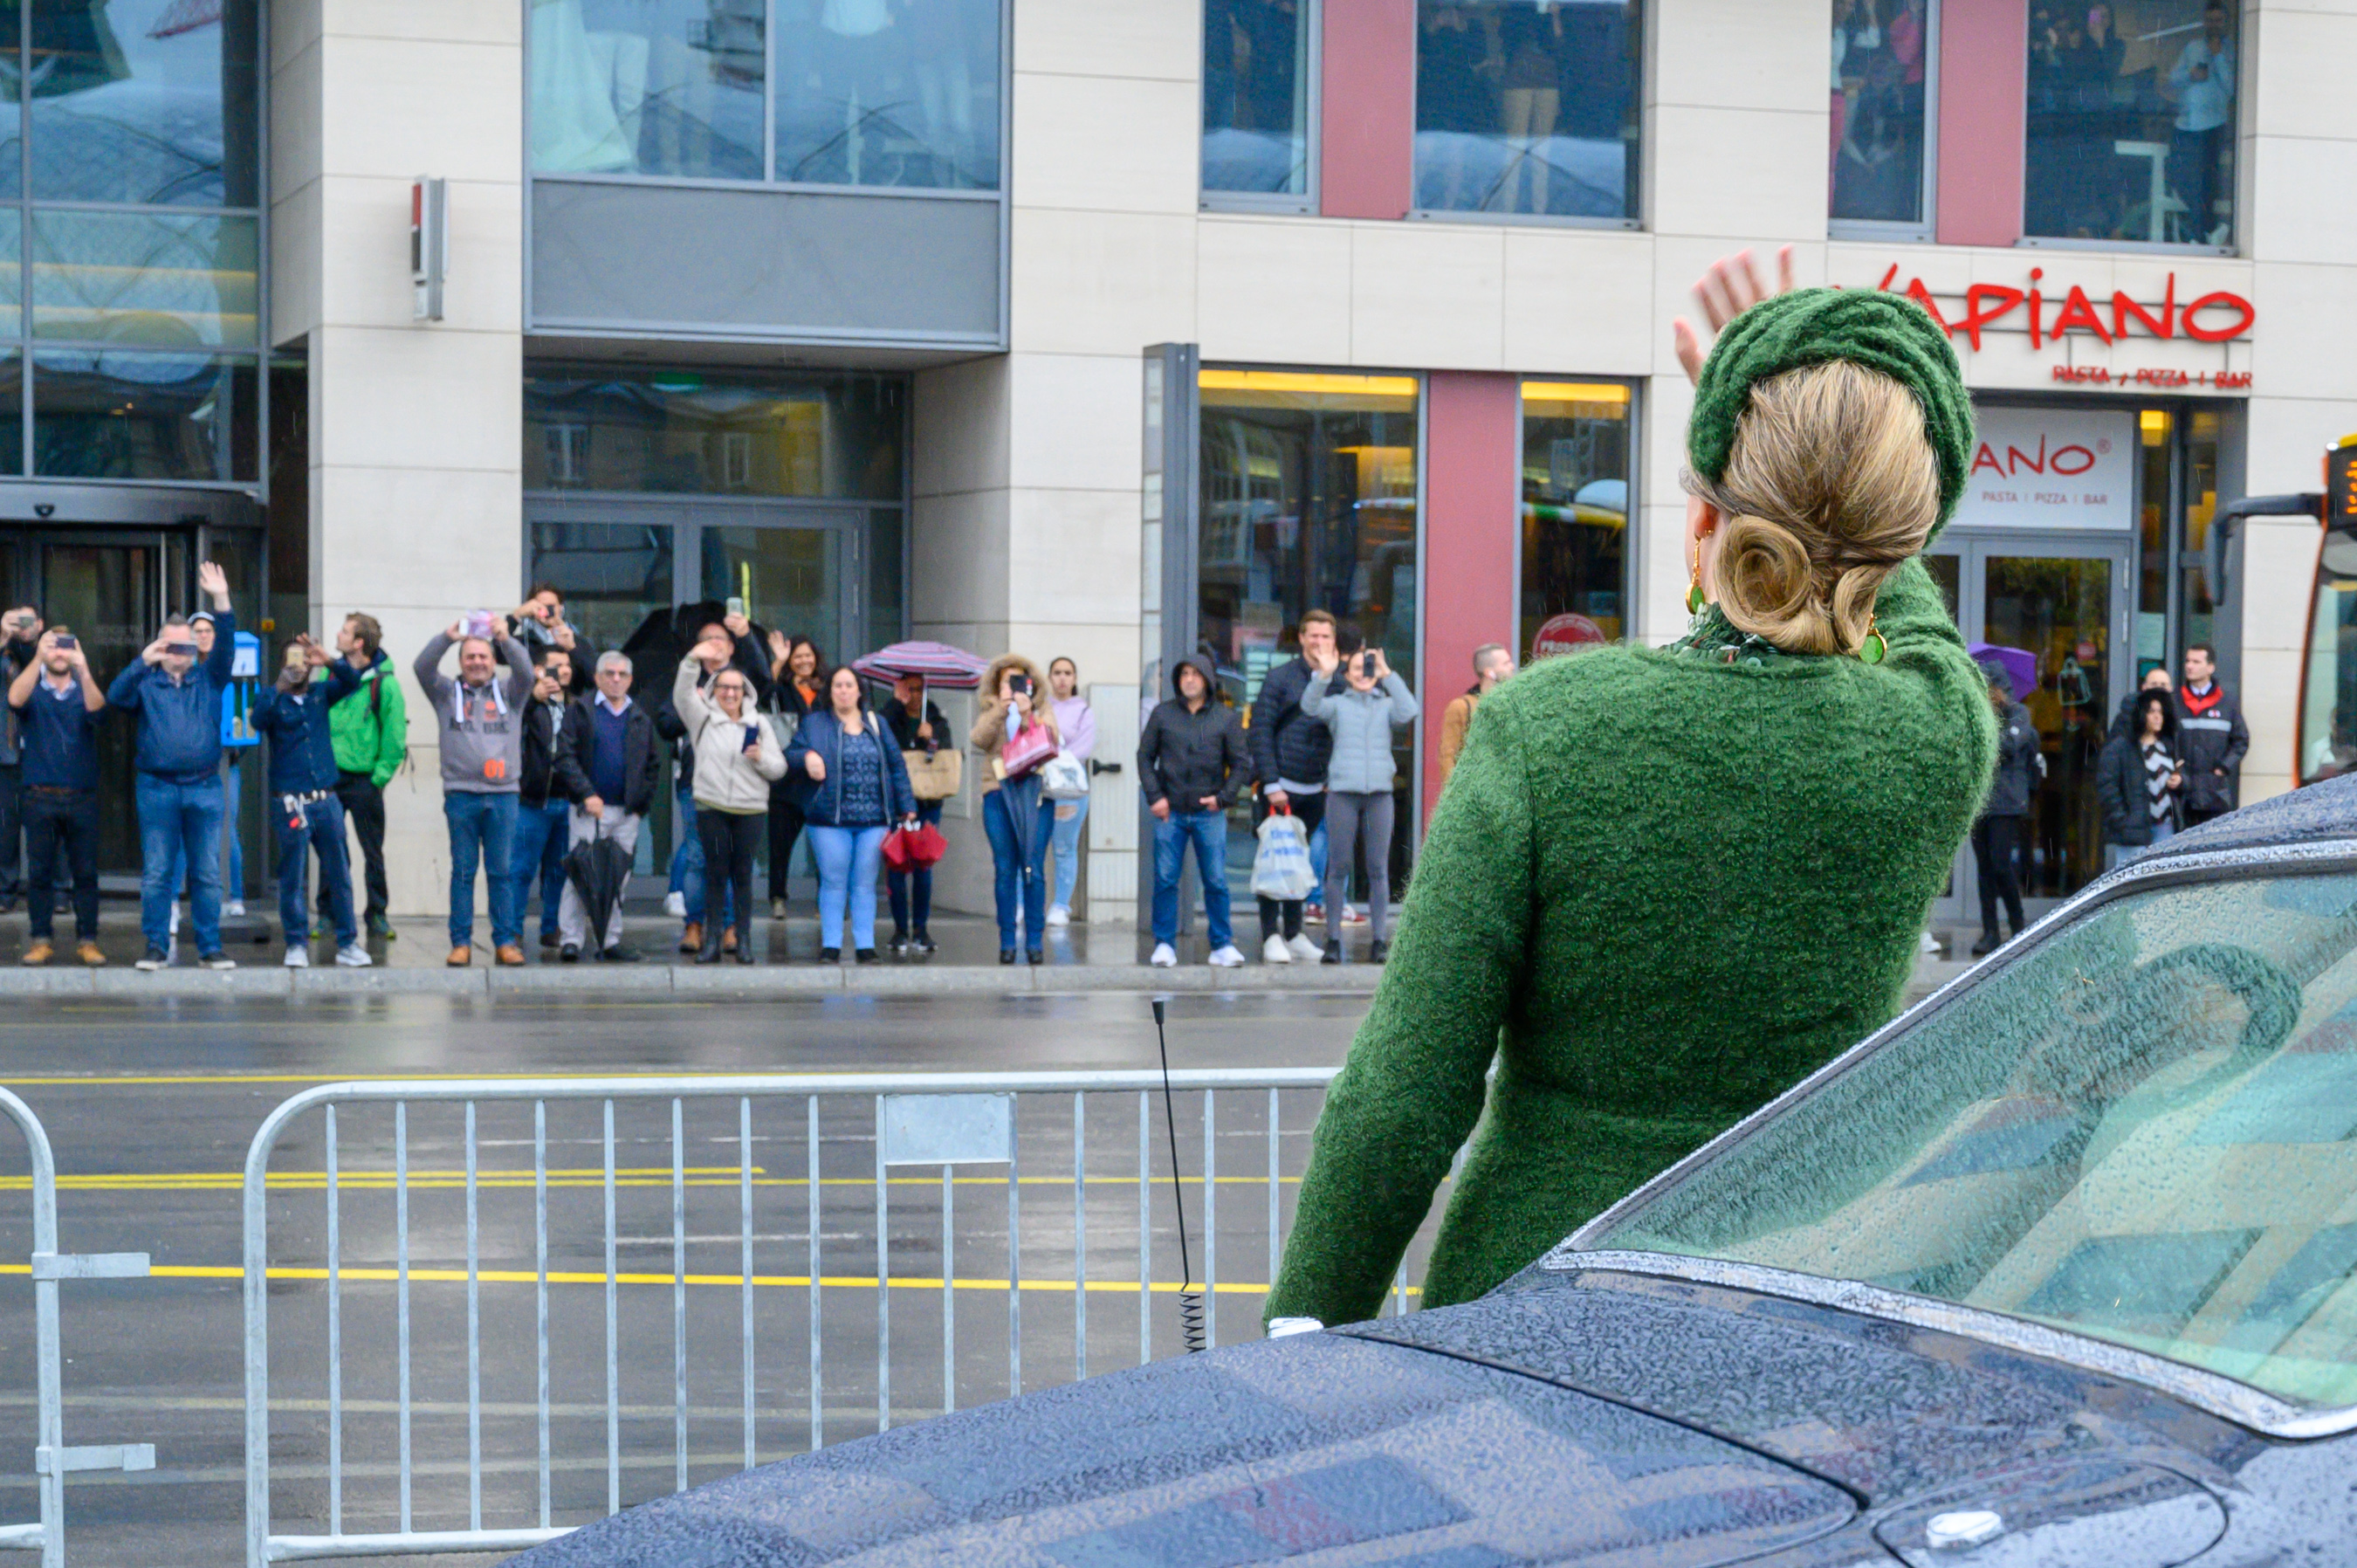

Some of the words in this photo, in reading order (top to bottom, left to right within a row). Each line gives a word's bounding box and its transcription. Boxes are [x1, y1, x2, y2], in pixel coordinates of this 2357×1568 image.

[2051, 365, 2111, 384] PASTA
[2136, 368, 2189, 388] PIZZA
[2215, 371, 2252, 389] BAR
[1982, 490, 2018, 504] PASTA
[2033, 491, 2069, 505] PIZZA
[2082, 492, 2109, 506] BAR
[484, 758, 505, 779] 01
